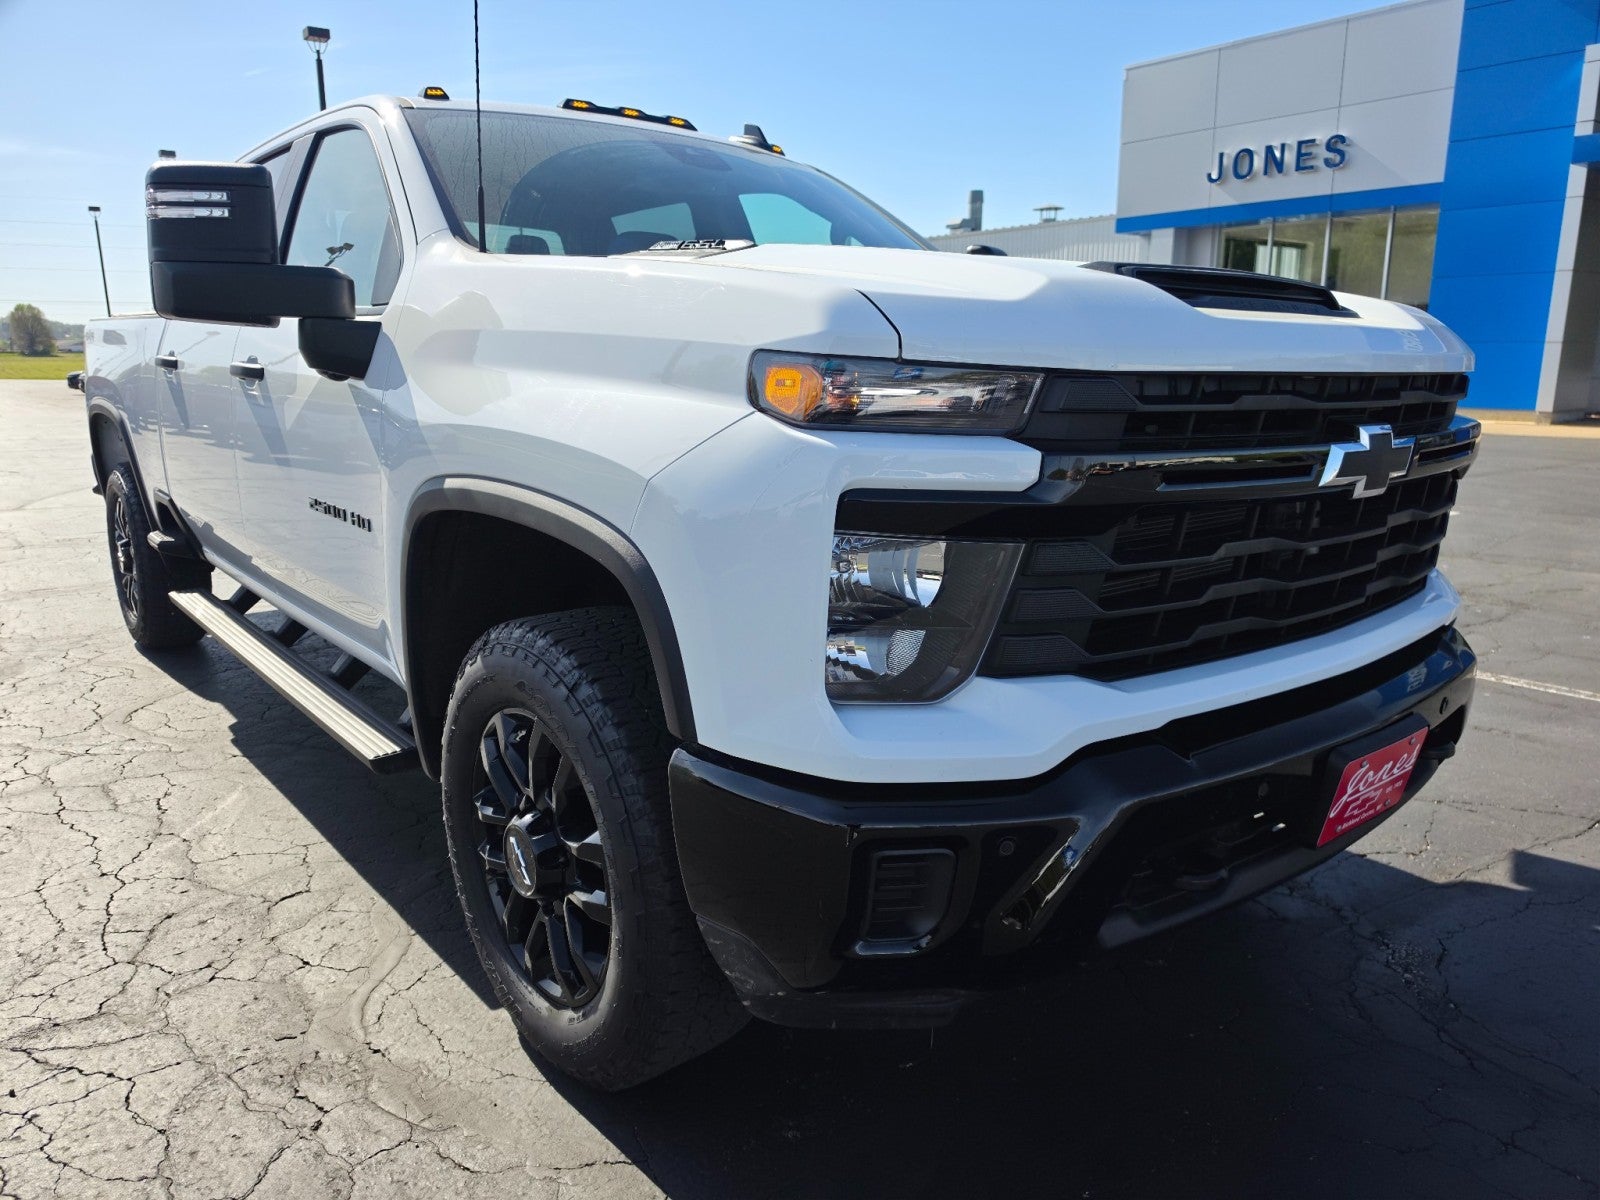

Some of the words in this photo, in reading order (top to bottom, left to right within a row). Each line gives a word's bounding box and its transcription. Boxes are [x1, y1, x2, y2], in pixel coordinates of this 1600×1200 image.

[1207, 134, 1350, 184] JONES
[308, 496, 347, 522] 2500
[1329, 744, 1421, 818] Jones
